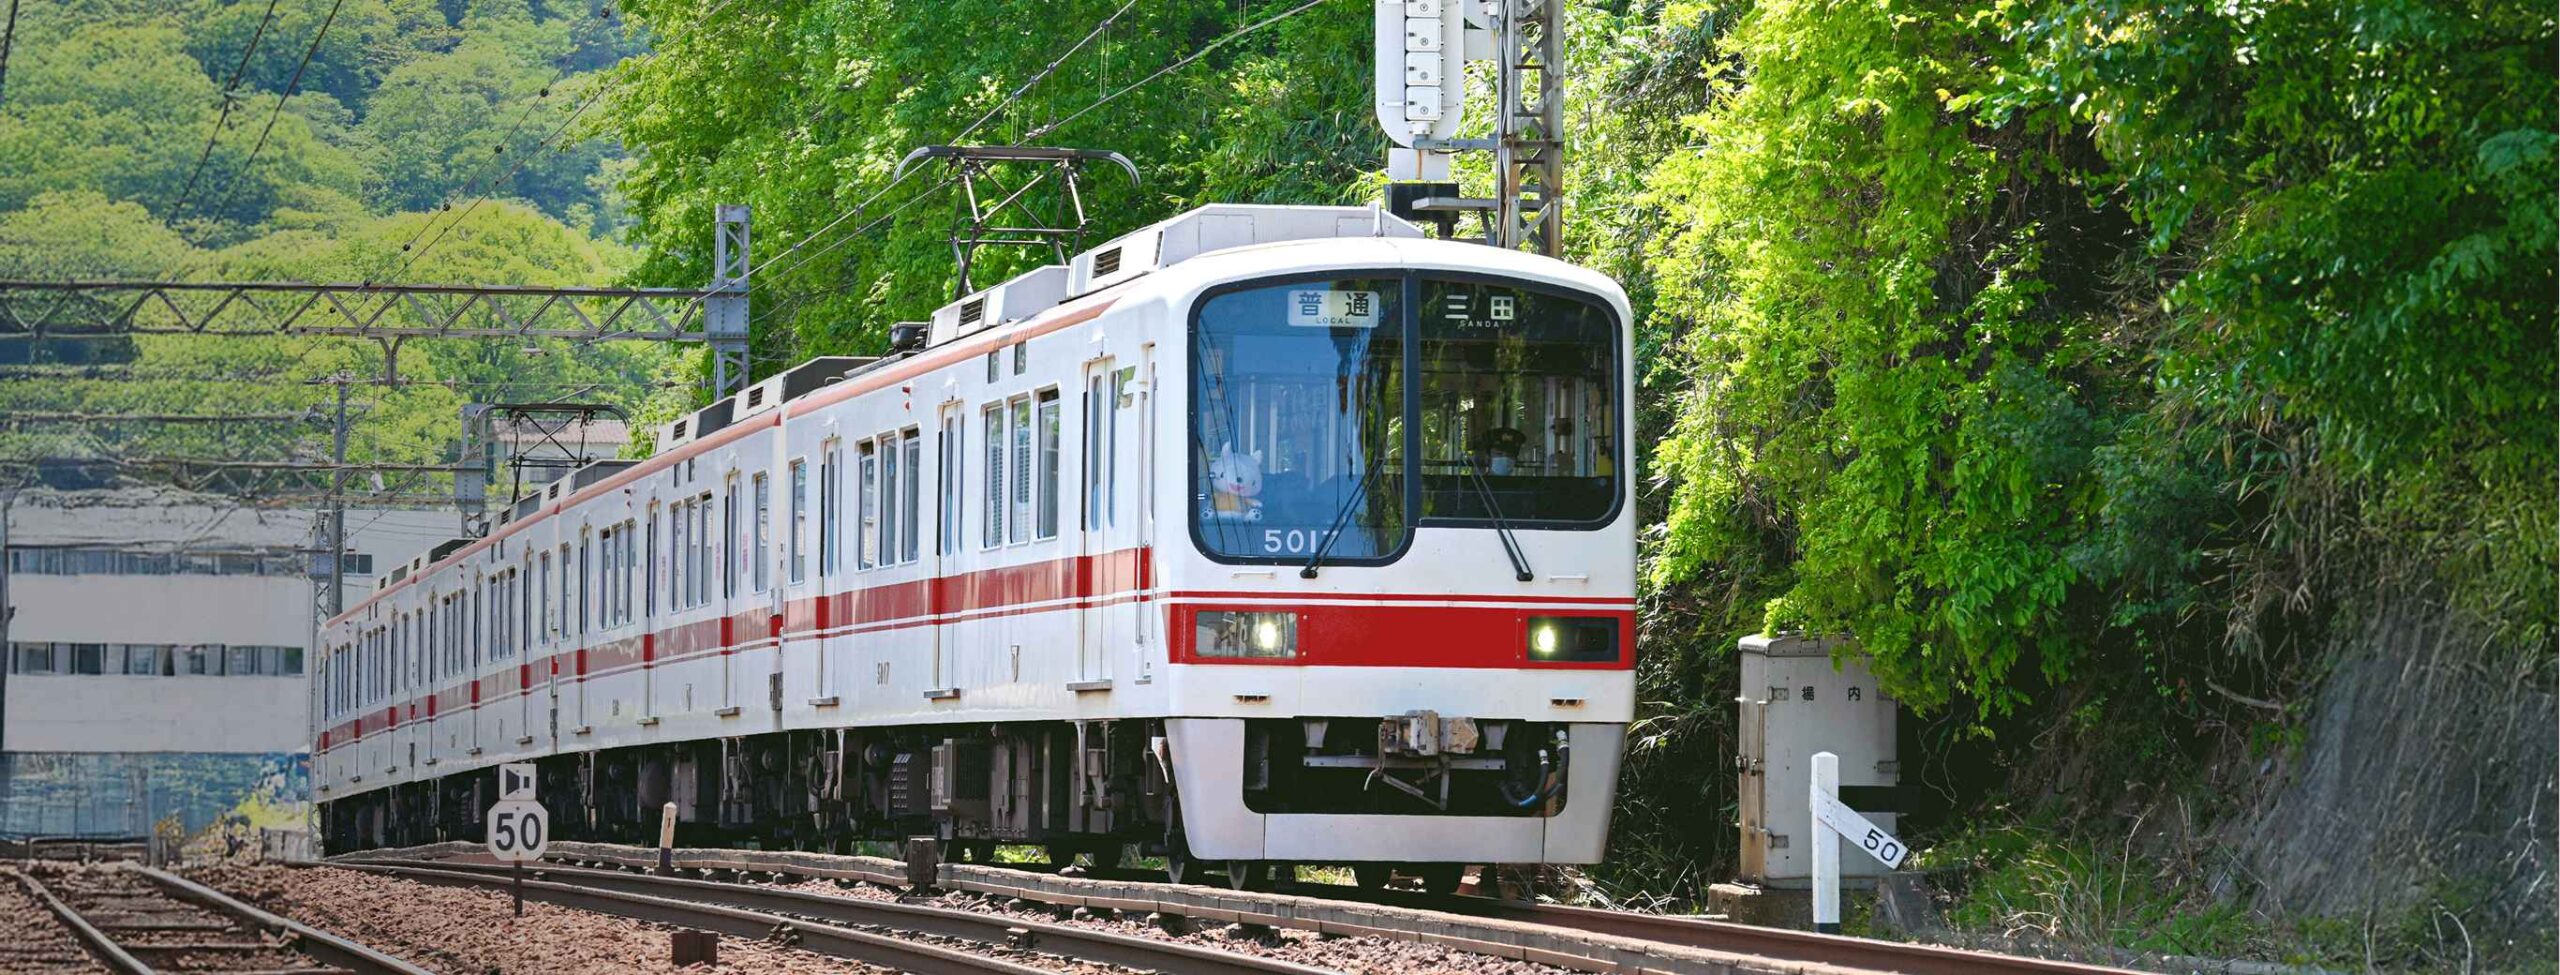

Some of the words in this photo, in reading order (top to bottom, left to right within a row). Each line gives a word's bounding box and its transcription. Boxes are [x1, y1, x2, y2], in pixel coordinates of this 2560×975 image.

[1298, 292, 1370, 317] 普通
[1445, 294, 1515, 320] 三田
[1316, 316, 1352, 325] LOCAL
[1459, 320, 1500, 328] SANDA
[495, 812, 541, 851] 50
[1864, 828, 1899, 862] 50
